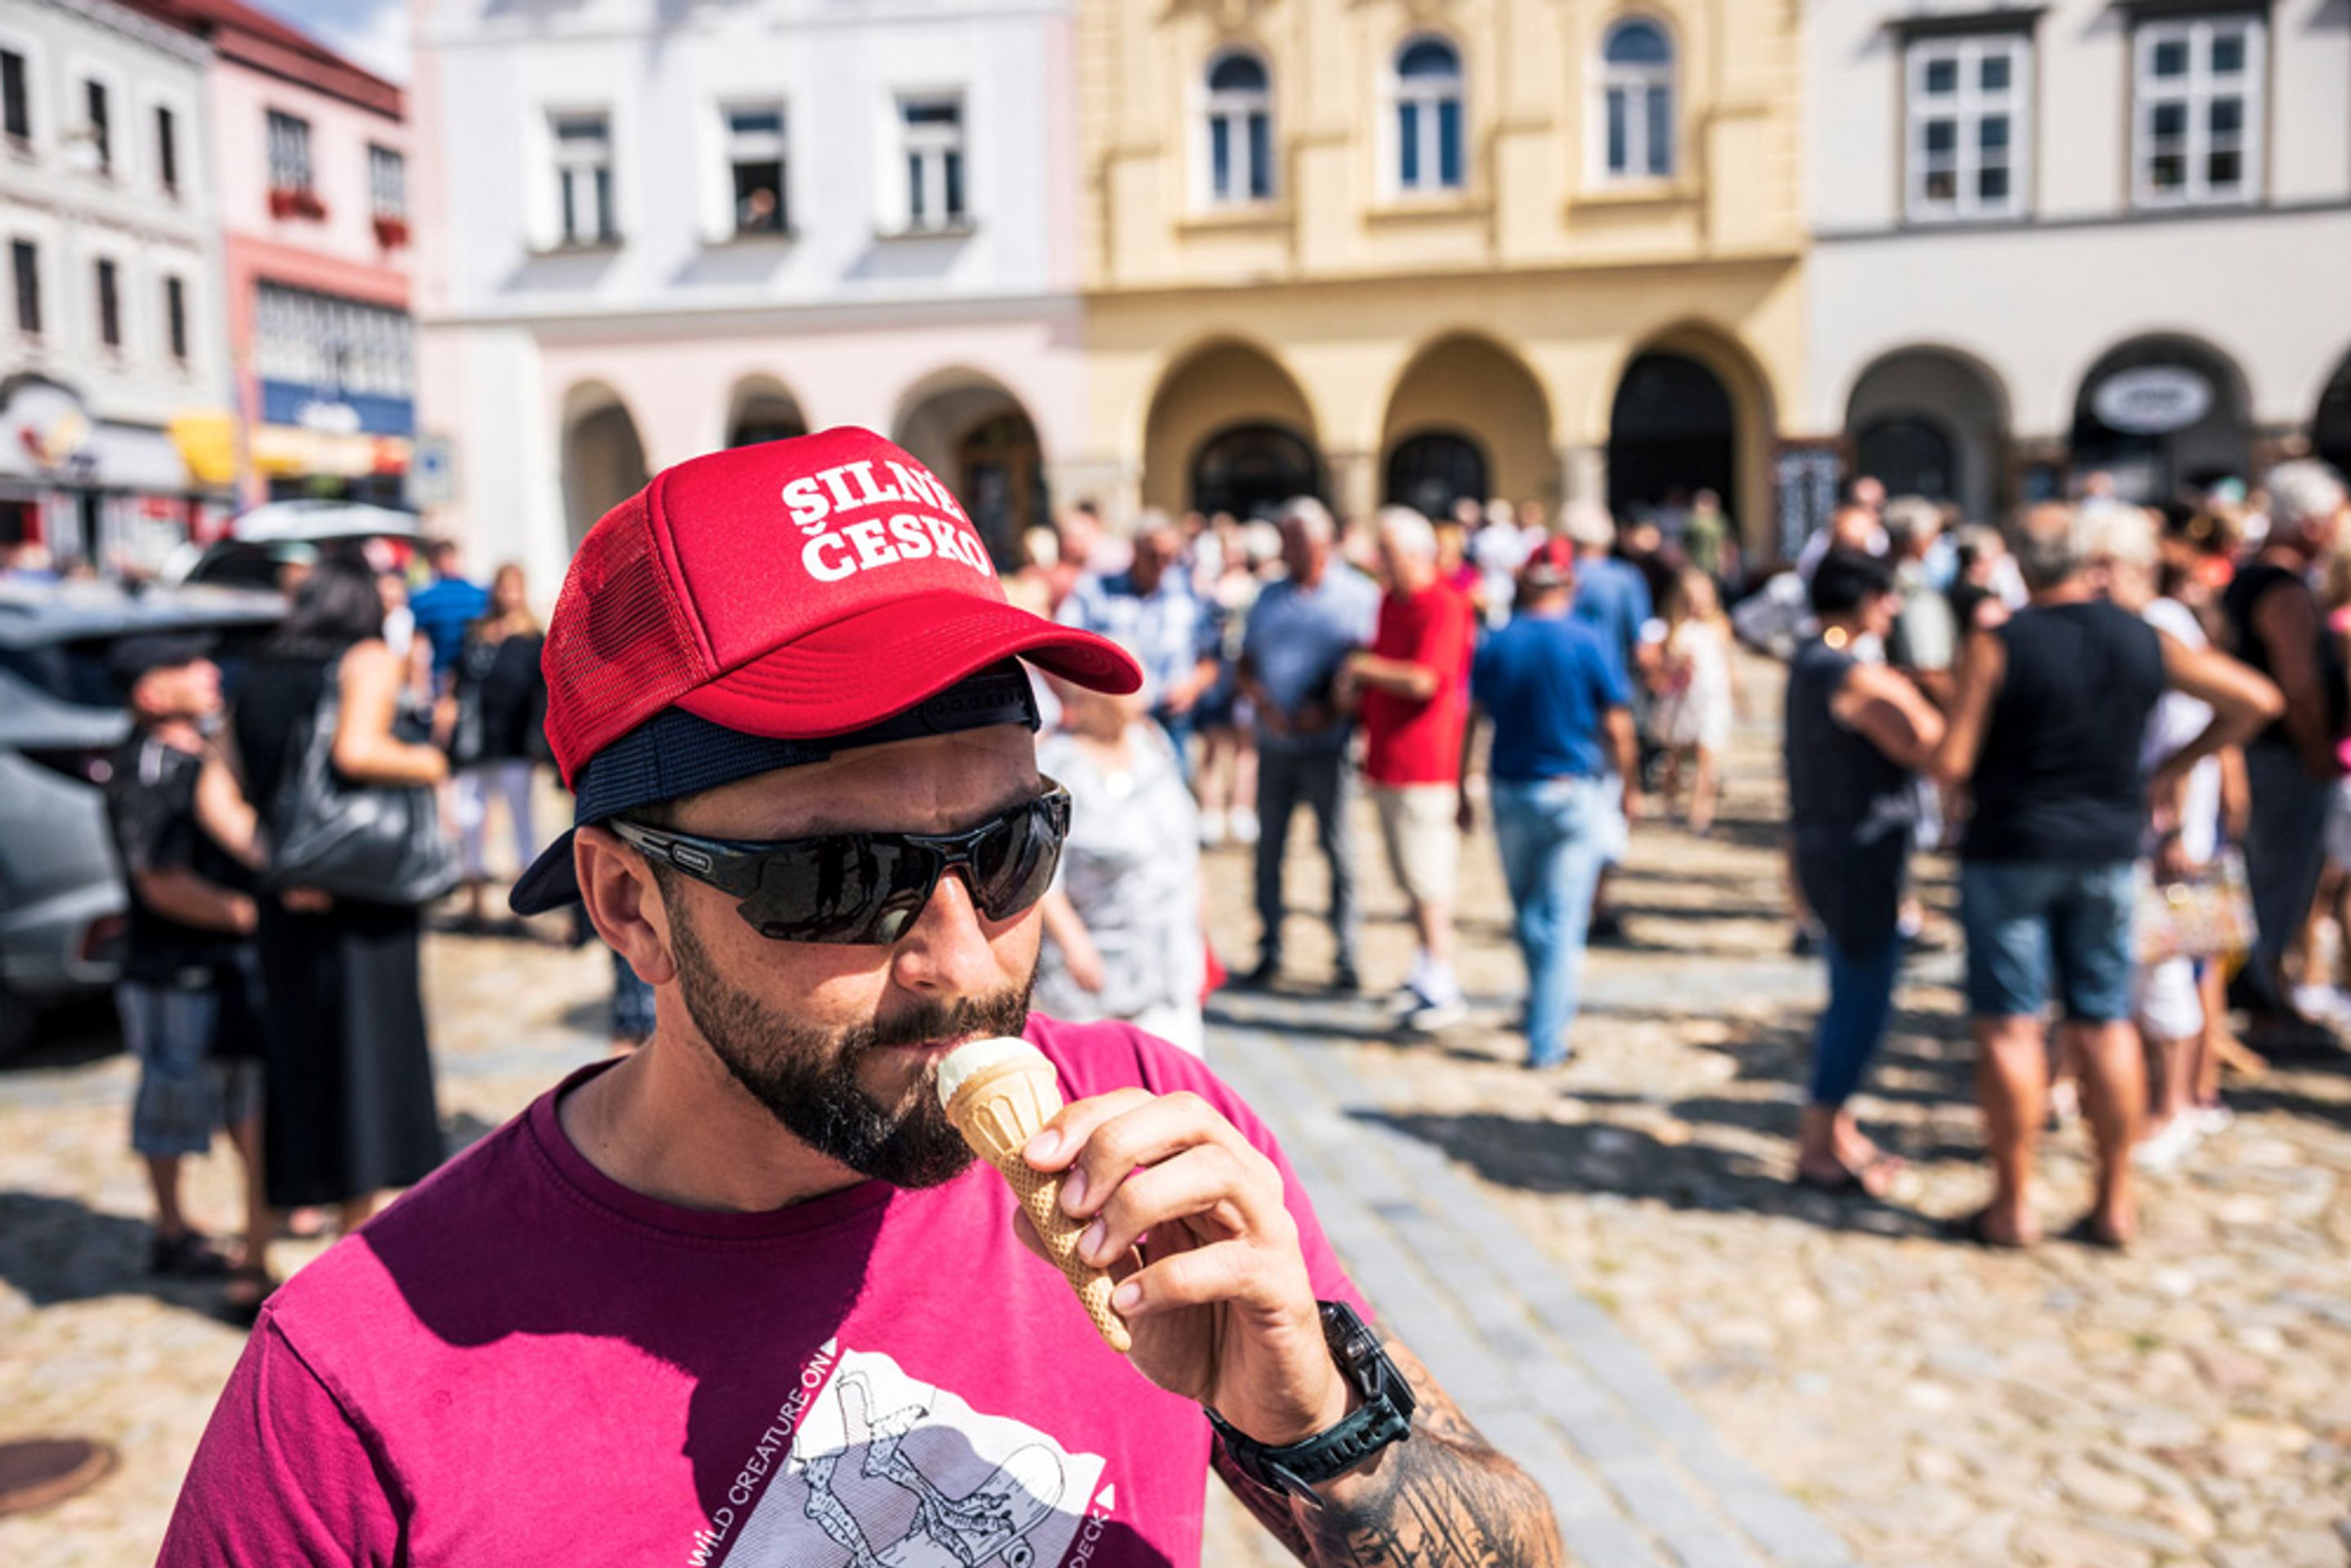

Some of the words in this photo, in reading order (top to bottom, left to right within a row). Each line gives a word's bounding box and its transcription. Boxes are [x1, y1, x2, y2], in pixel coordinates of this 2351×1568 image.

[801, 514, 991, 581] ČESKO
[728, 1387, 811, 1505] CREATURE
[800, 1352, 833, 1388] ON
